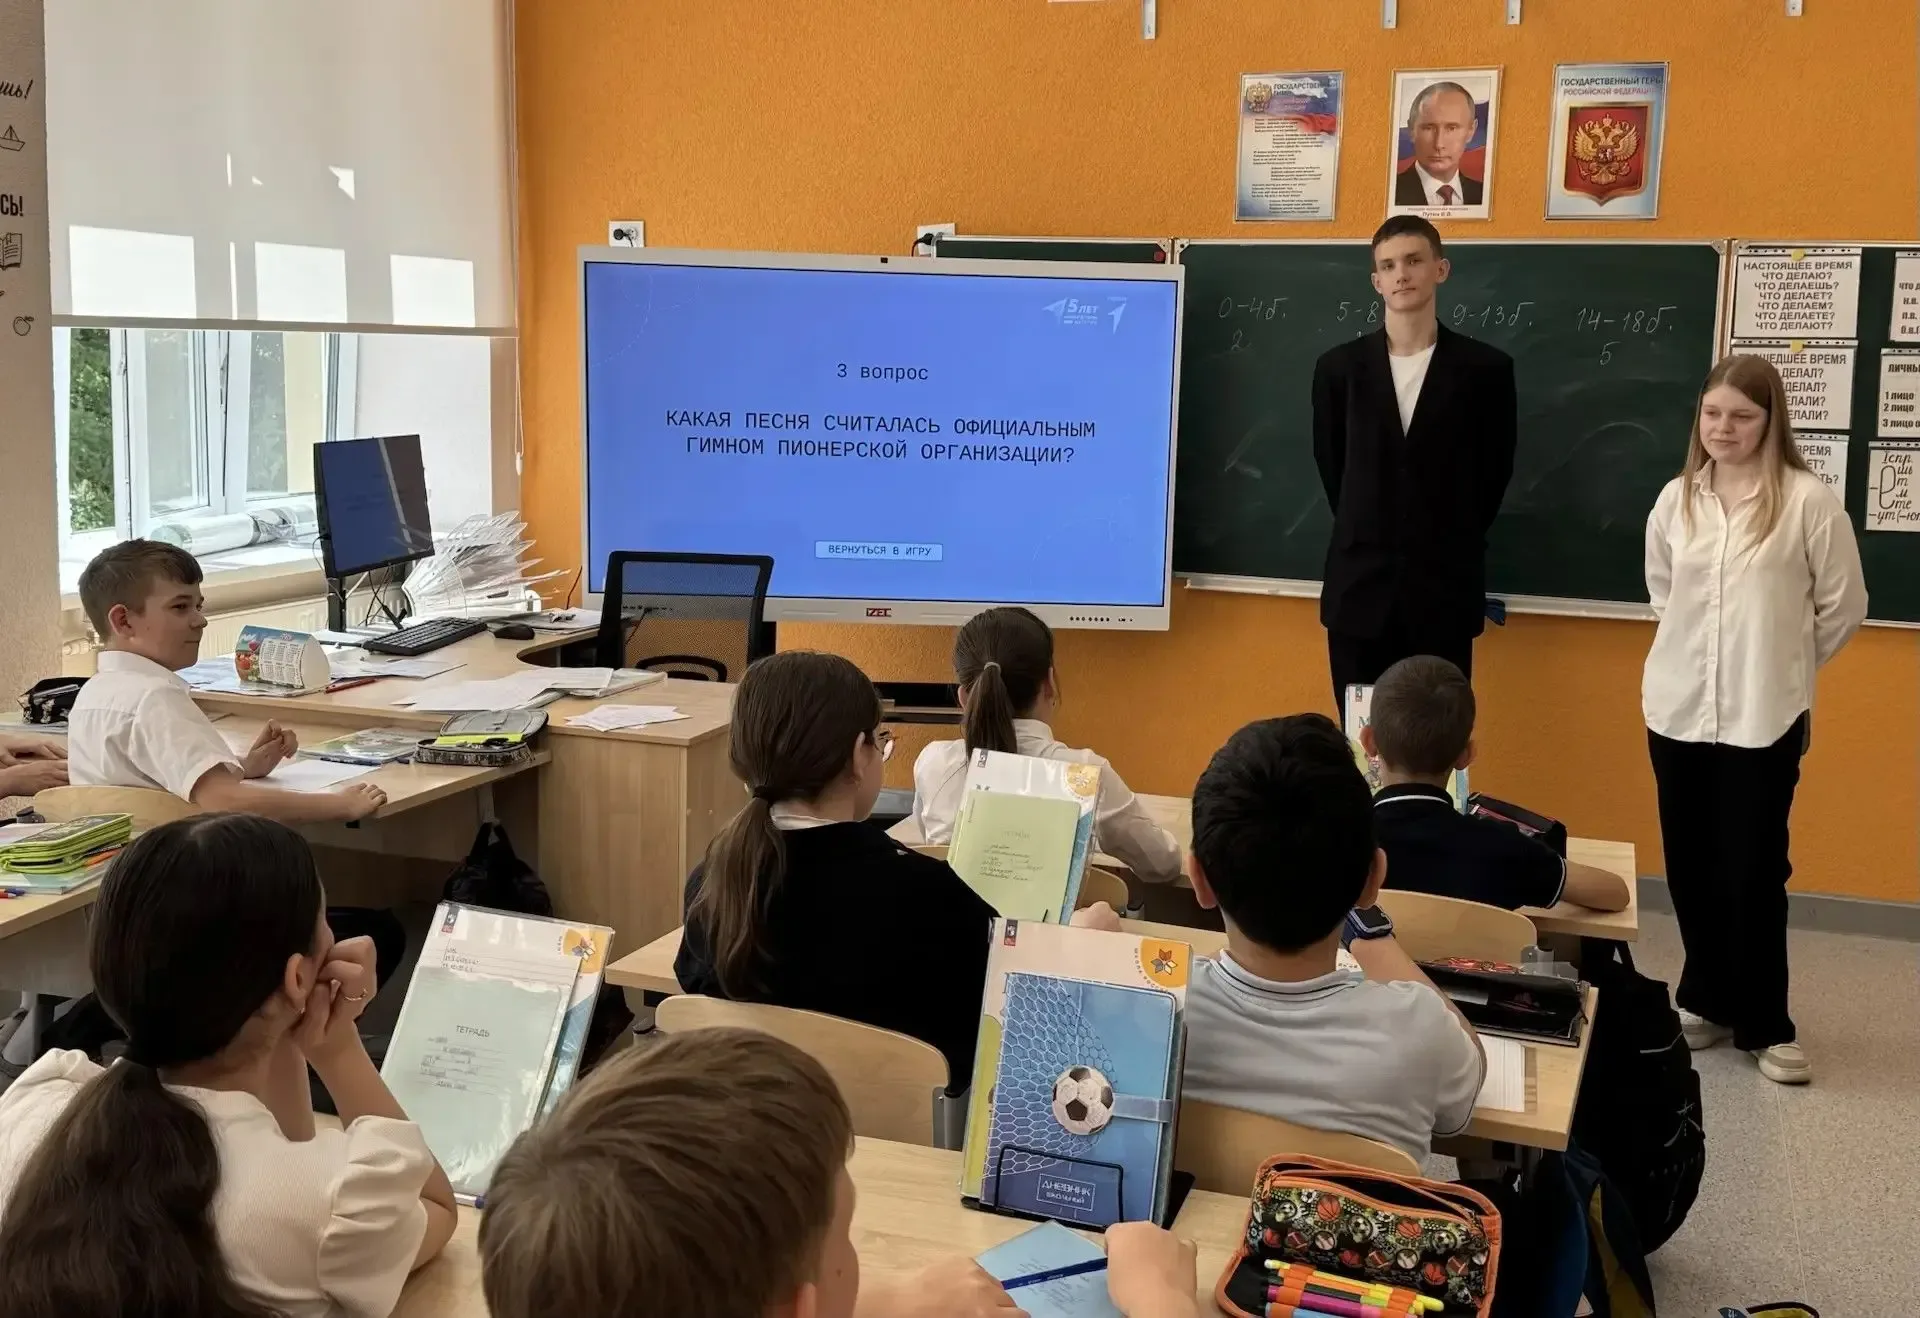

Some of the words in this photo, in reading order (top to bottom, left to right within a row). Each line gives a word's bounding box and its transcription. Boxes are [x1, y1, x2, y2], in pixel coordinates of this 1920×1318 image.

[1560, 76, 1639, 86] ГОСУДАРСТВЕННЫЙ
[1563, 87, 1612, 96] РОССИЙСКОЙ
[1743, 261, 1812, 270] НАСТОЯЩЕЕ
[1815, 261, 1853, 270] ВРЕМЯ
[1761, 272, 1784, 280] ЧТО
[1785, 272, 1832, 280] ДЕЛАЮ?
[1754, 282, 1776, 290] ЧТО
[1778, 282, 1839, 291] ДЕЛАЕШЬ?
[1759, 292, 1781, 300] ЧТО
[1783, 292, 1833, 301] ДЕЛАЕТ?
[1758, 302, 1779, 310] ЧТО
[1781, 302, 1834, 310] ДЕЛАЕМ?
[1755, 312, 1776, 320] ЧТО
[1779, 312, 1835, 320] ДЕЛАЕТЕ?
[1756, 322, 1778, 330] ЧТО
[1780, 322, 1833, 330] ДЕЛАЮТ?
[1600, 341, 1621, 365] 5
[1810, 354, 1847, 365] ВРЕМЯ
[837, 363, 848, 378] 3
[860, 365, 929, 383] вопрос
[1784, 382, 1827, 393] ДЕЛАЛ?
[1885, 391, 1890, 400] 1
[1883, 403, 1889, 412] 2
[666, 410, 731, 427] КАКАЯ
[745, 412, 810, 430] ПЕСНЯ
[823, 414, 941, 433] СЧИТАЛАСЬ
[954, 418, 1096, 440] ОФИЦИАЛЬНЫМ
[1882, 418, 1889, 428] 3
[686, 437, 764, 454] ГИМНОМ
[778, 439, 907, 459] ПИОНЕРСКОЙ
[921, 443, 1075, 466] ОРГАНИЗАЦИИ?
[828, 544, 886, 555] ВЕРНУТЬСЯ
[893, 546, 900, 556] В
[905, 547, 932, 556] ИГРУ
[456, 1025, 490, 1038] ТЕТРАДЬ
[1041, 1180, 1091, 1197] ДНЕВНИК
